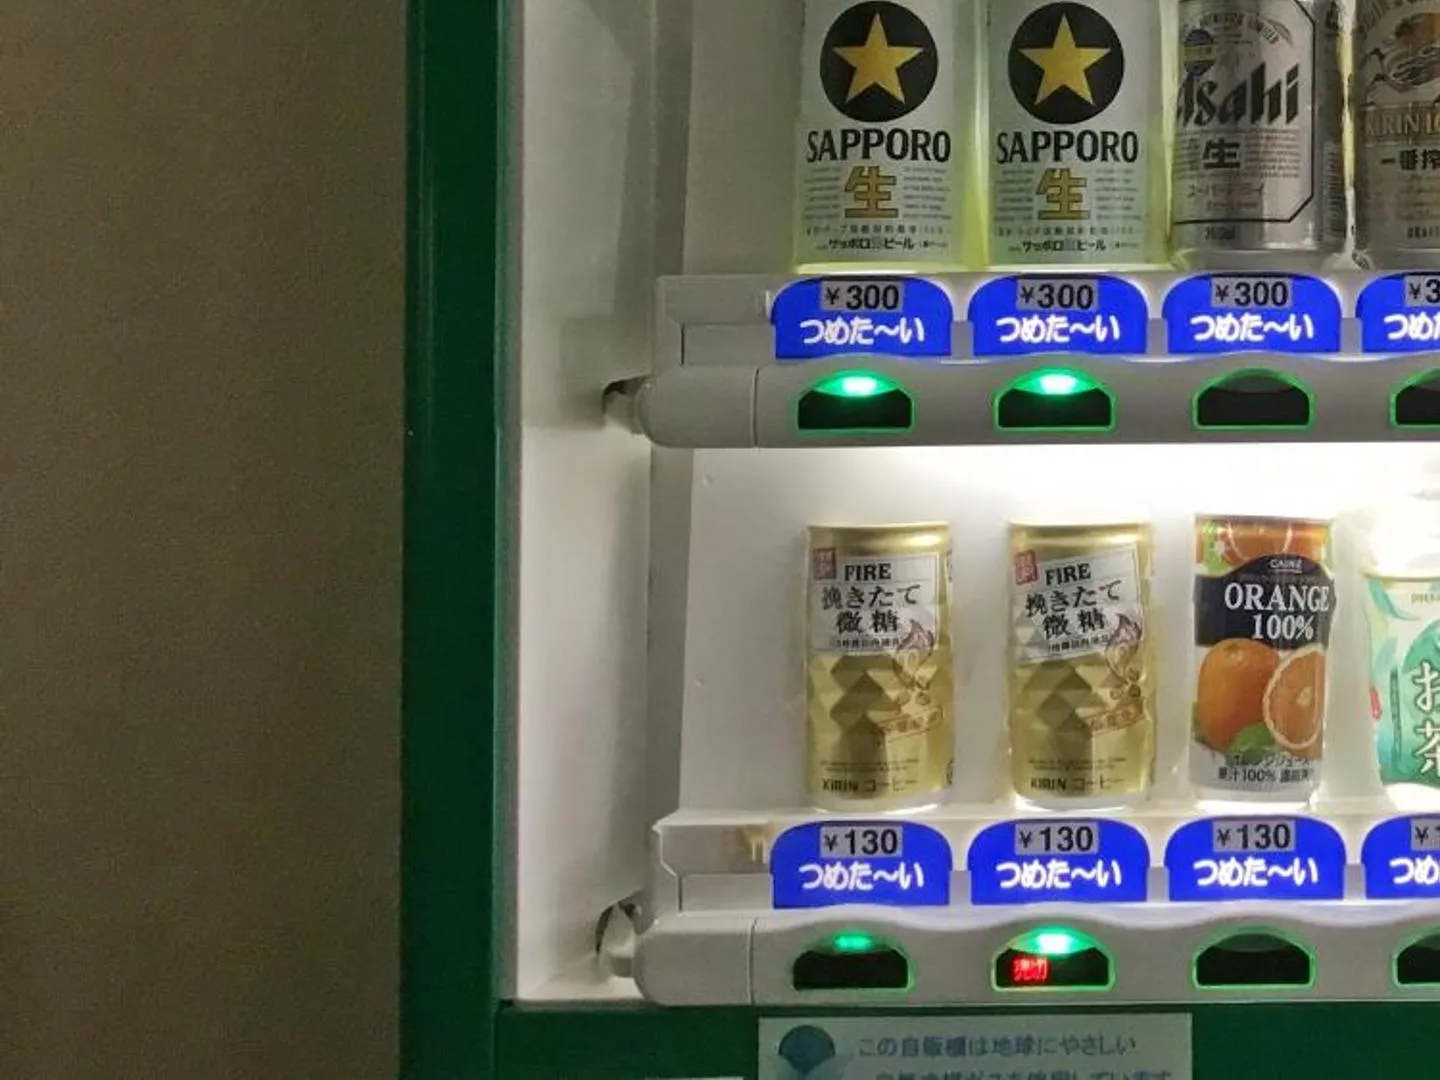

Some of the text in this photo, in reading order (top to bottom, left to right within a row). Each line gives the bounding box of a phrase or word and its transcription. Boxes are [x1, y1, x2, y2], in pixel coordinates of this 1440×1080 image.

[1177, 62, 1300, 127] Asahi
[805, 128, 952, 163] SAPPORO
[995, 129, 1139, 164] SAPPORO
[1203, 137, 1241, 169] 生
[844, 165, 898, 219] 生
[1036, 167, 1090, 220] 生
[826, 285, 899, 310] ¥300
[1020, 285, 1094, 310] ¥300
[1215, 282, 1289, 306] ¥300
[844, 562, 892, 581] FIRE
[1045, 562, 1092, 587] FIRE
[821, 584, 921, 610] 挽きたて
[1025, 579, 1122, 618] 挽きたて
[1224, 582, 1332, 613] ORANGE
[1250, 613, 1315, 640] 100%
[824, 831, 897, 855] ¥130
[1019, 828, 1094, 853] ¥130
[1216, 825, 1291, 850] ¥130
